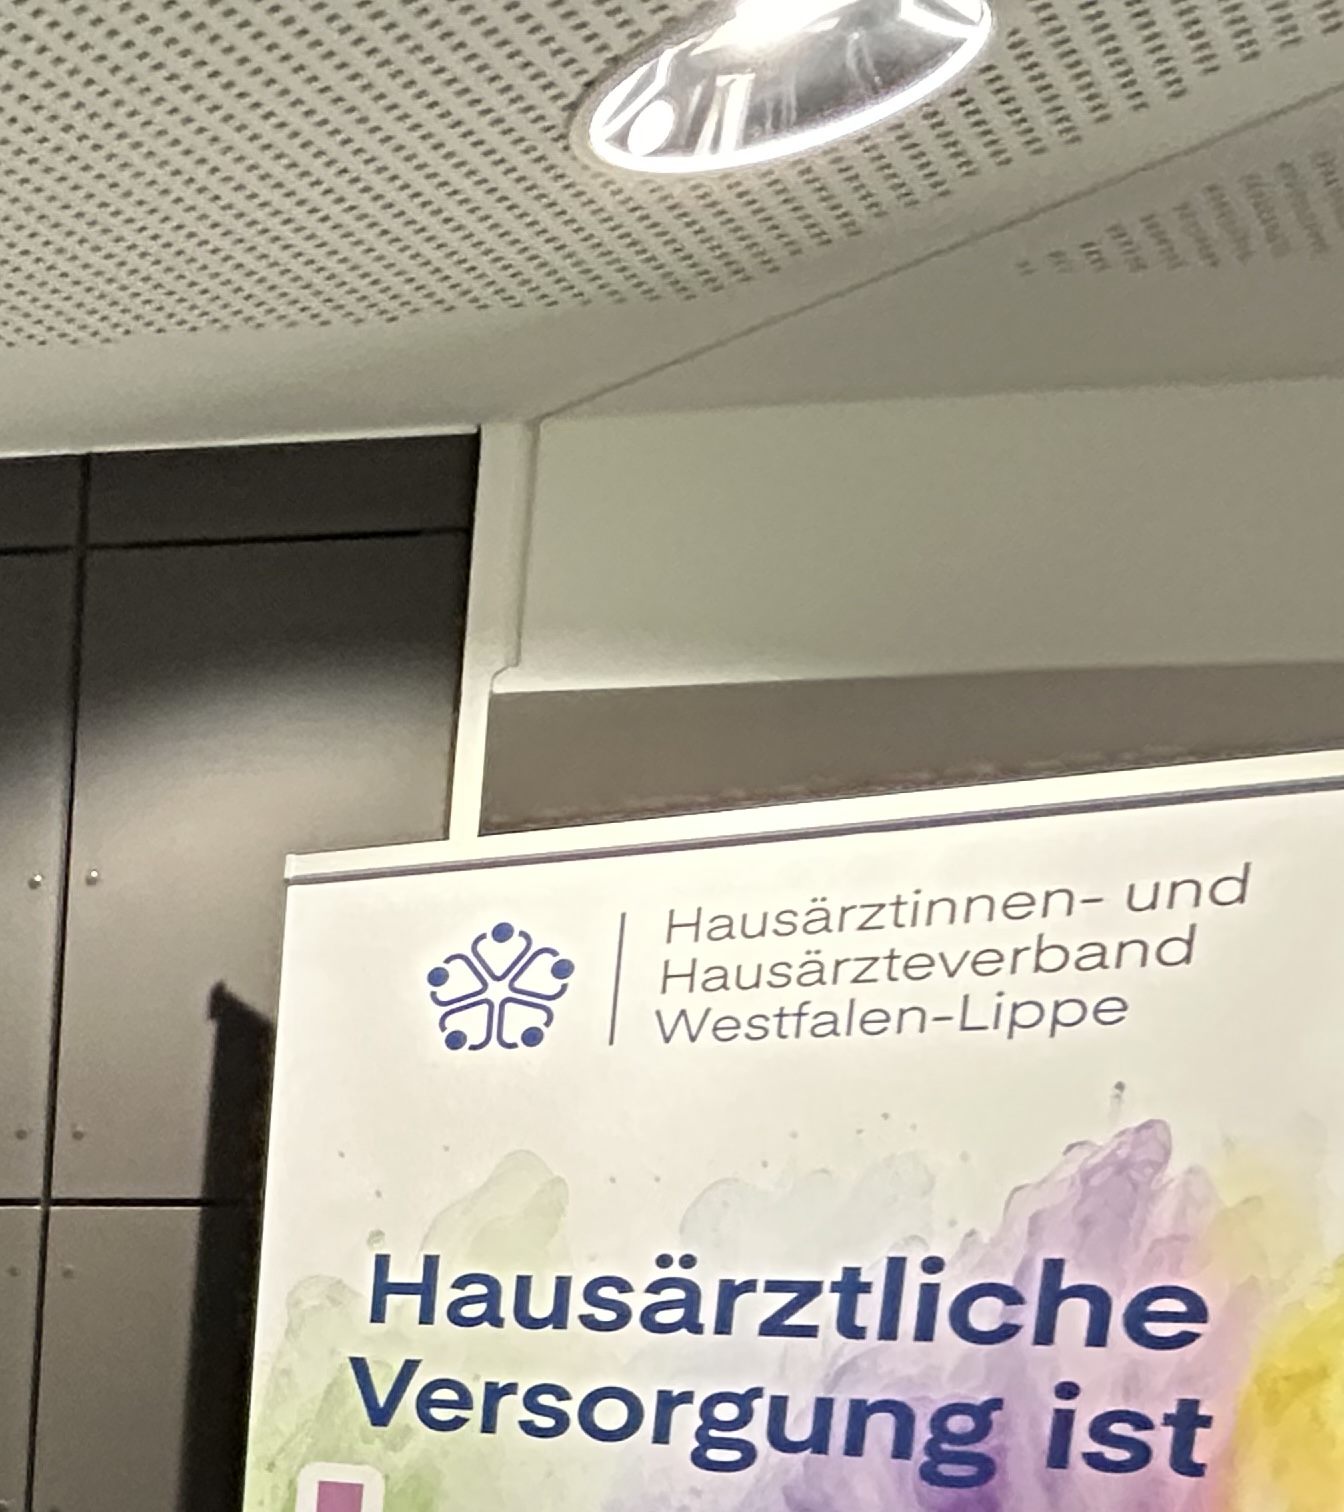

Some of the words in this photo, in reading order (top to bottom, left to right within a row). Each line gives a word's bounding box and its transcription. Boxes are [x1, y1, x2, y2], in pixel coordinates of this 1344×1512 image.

[666, 888, 1105, 945] Hausärztinnen-
[1126, 861, 1252, 913] und
[660, 922, 1198, 995] Hausärzteverband
[654, 990, 1129, 1044] Westfalen-Lippe
[369, 1253, 1209, 1351] Hausärztliche
[348, 1357, 1005, 1490] Versorgung
[1045, 1380, 1214, 1478] ist
